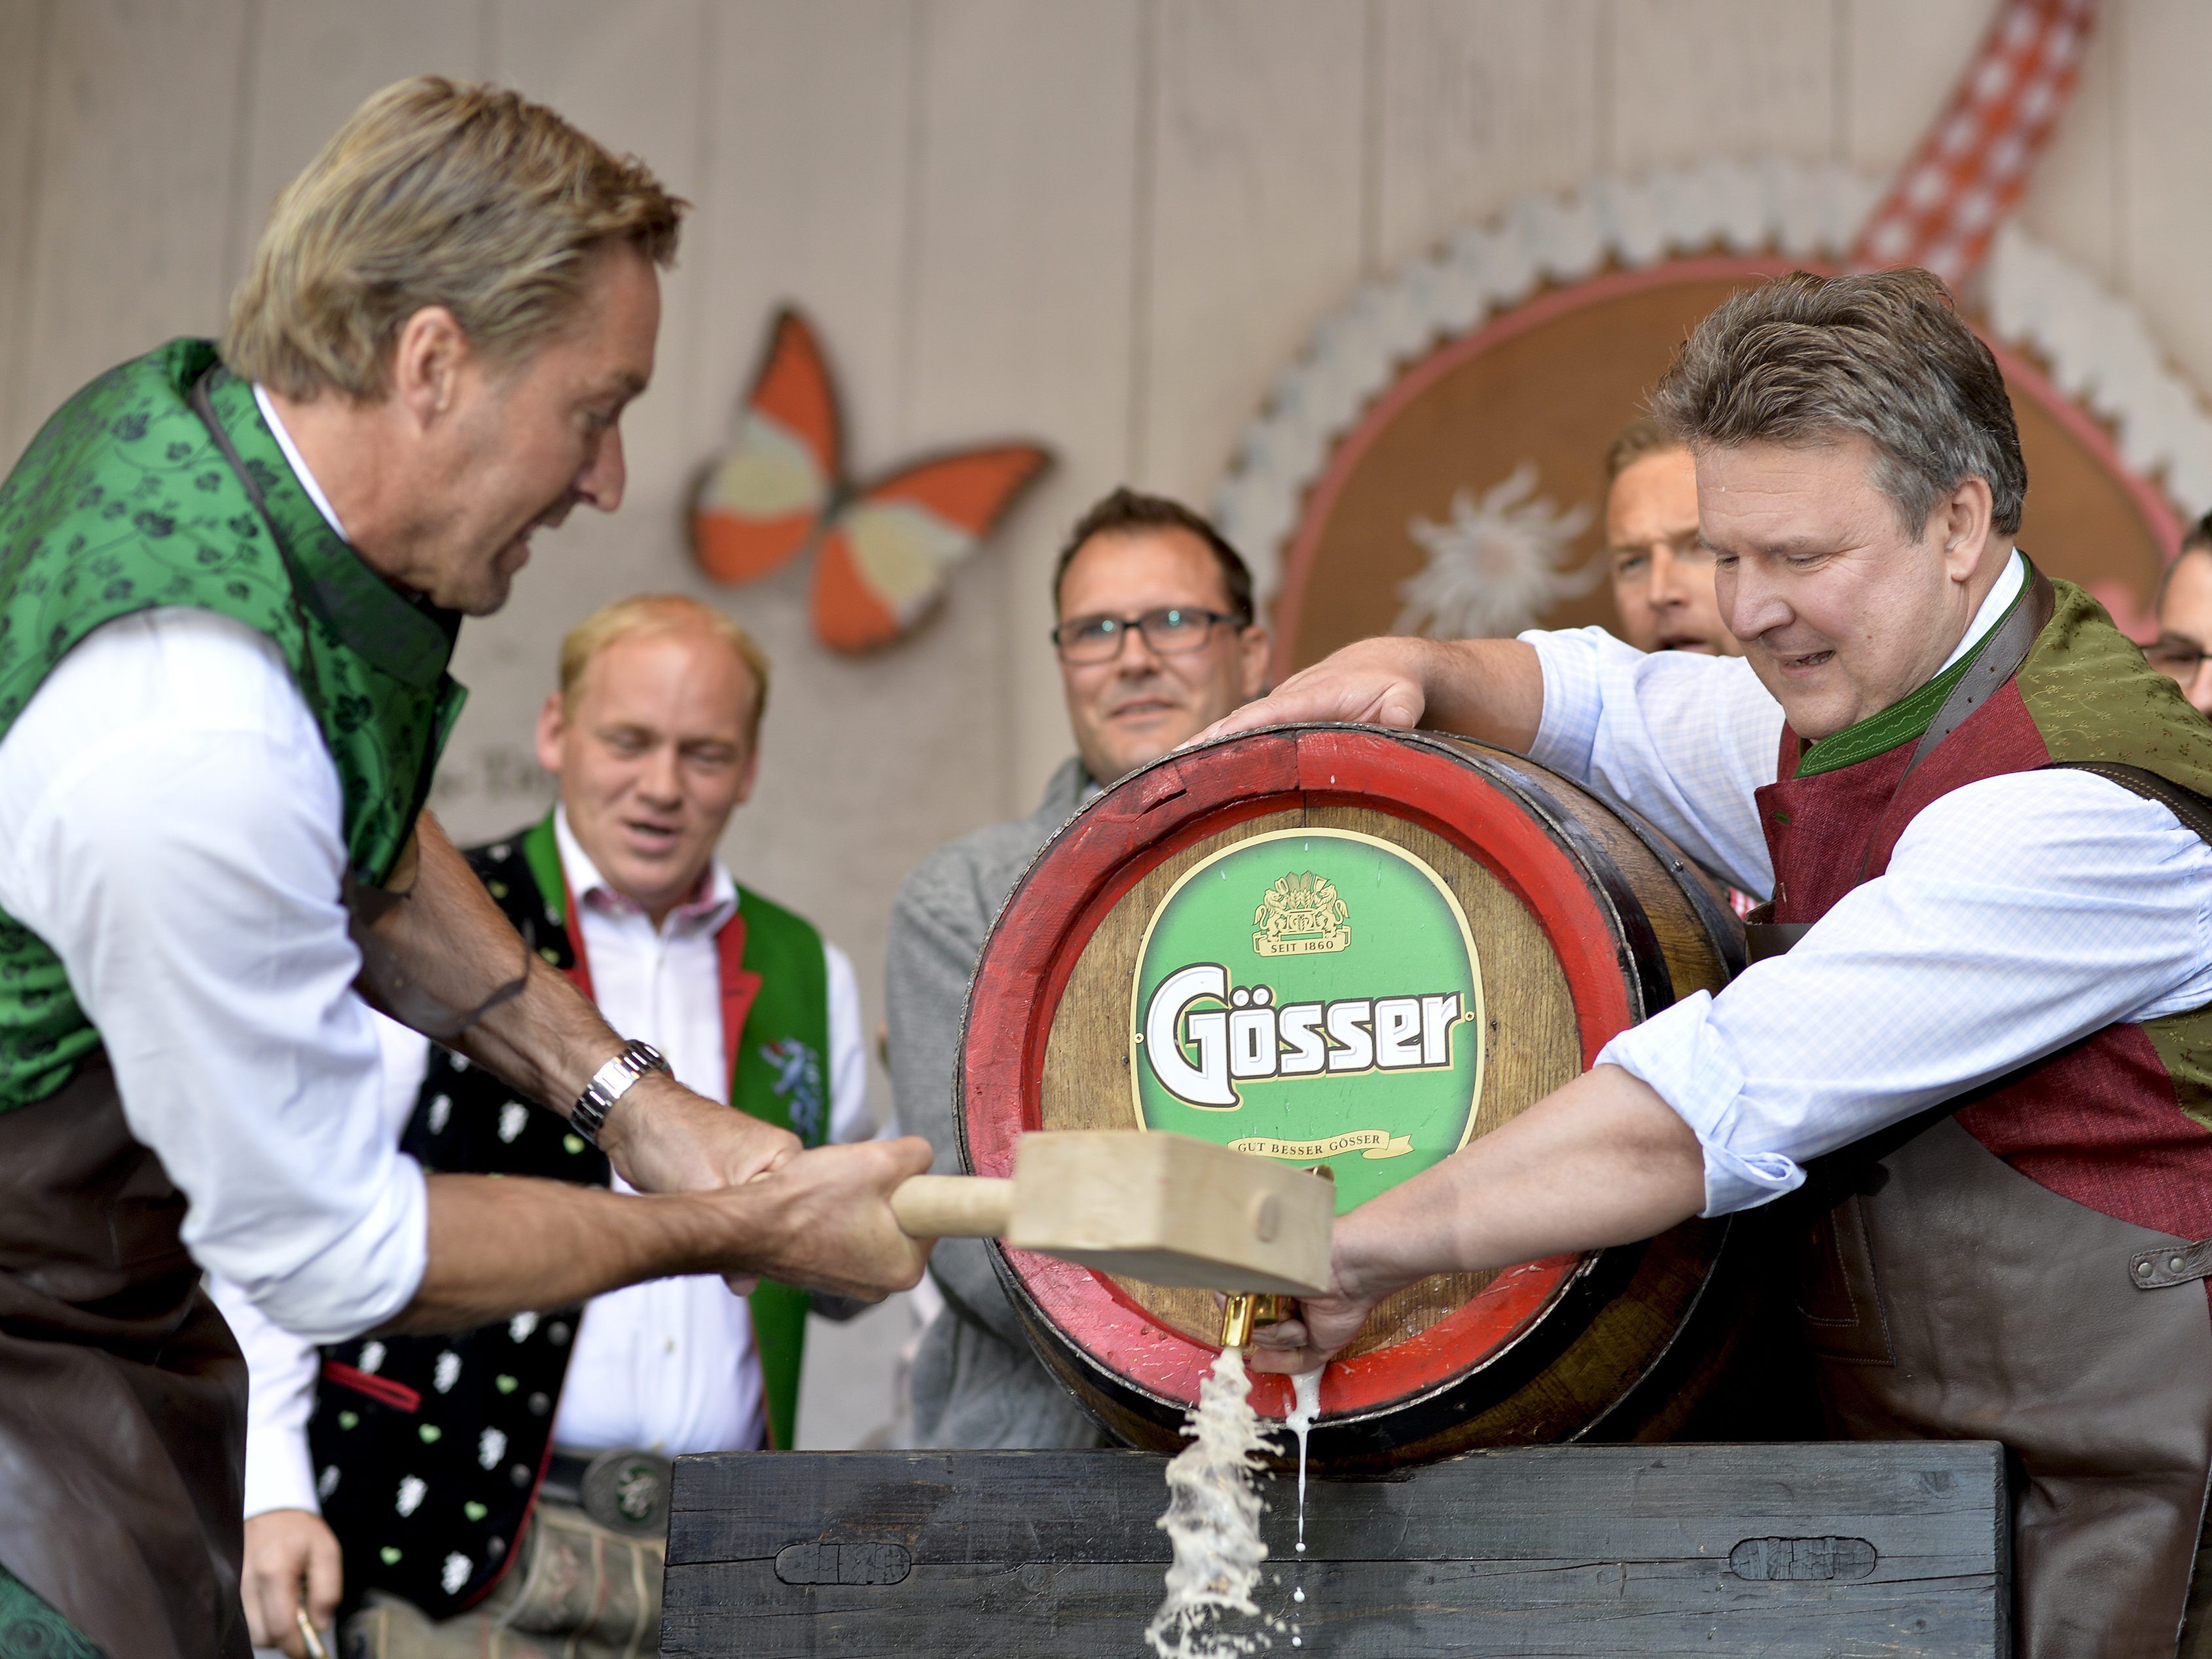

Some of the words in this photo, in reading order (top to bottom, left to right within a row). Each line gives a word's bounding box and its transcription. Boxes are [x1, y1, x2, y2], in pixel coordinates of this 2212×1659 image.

[1271, 943, 1297, 953] SEIT
[1305, 940, 1333, 951] 1860
[1145, 962, 1461, 1108] Gösser
[1238, 1142, 1266, 1152] GUT
[1271, 1143, 1323, 1156] BESSER
[1329, 1134, 1380, 1151] GÖSSER
